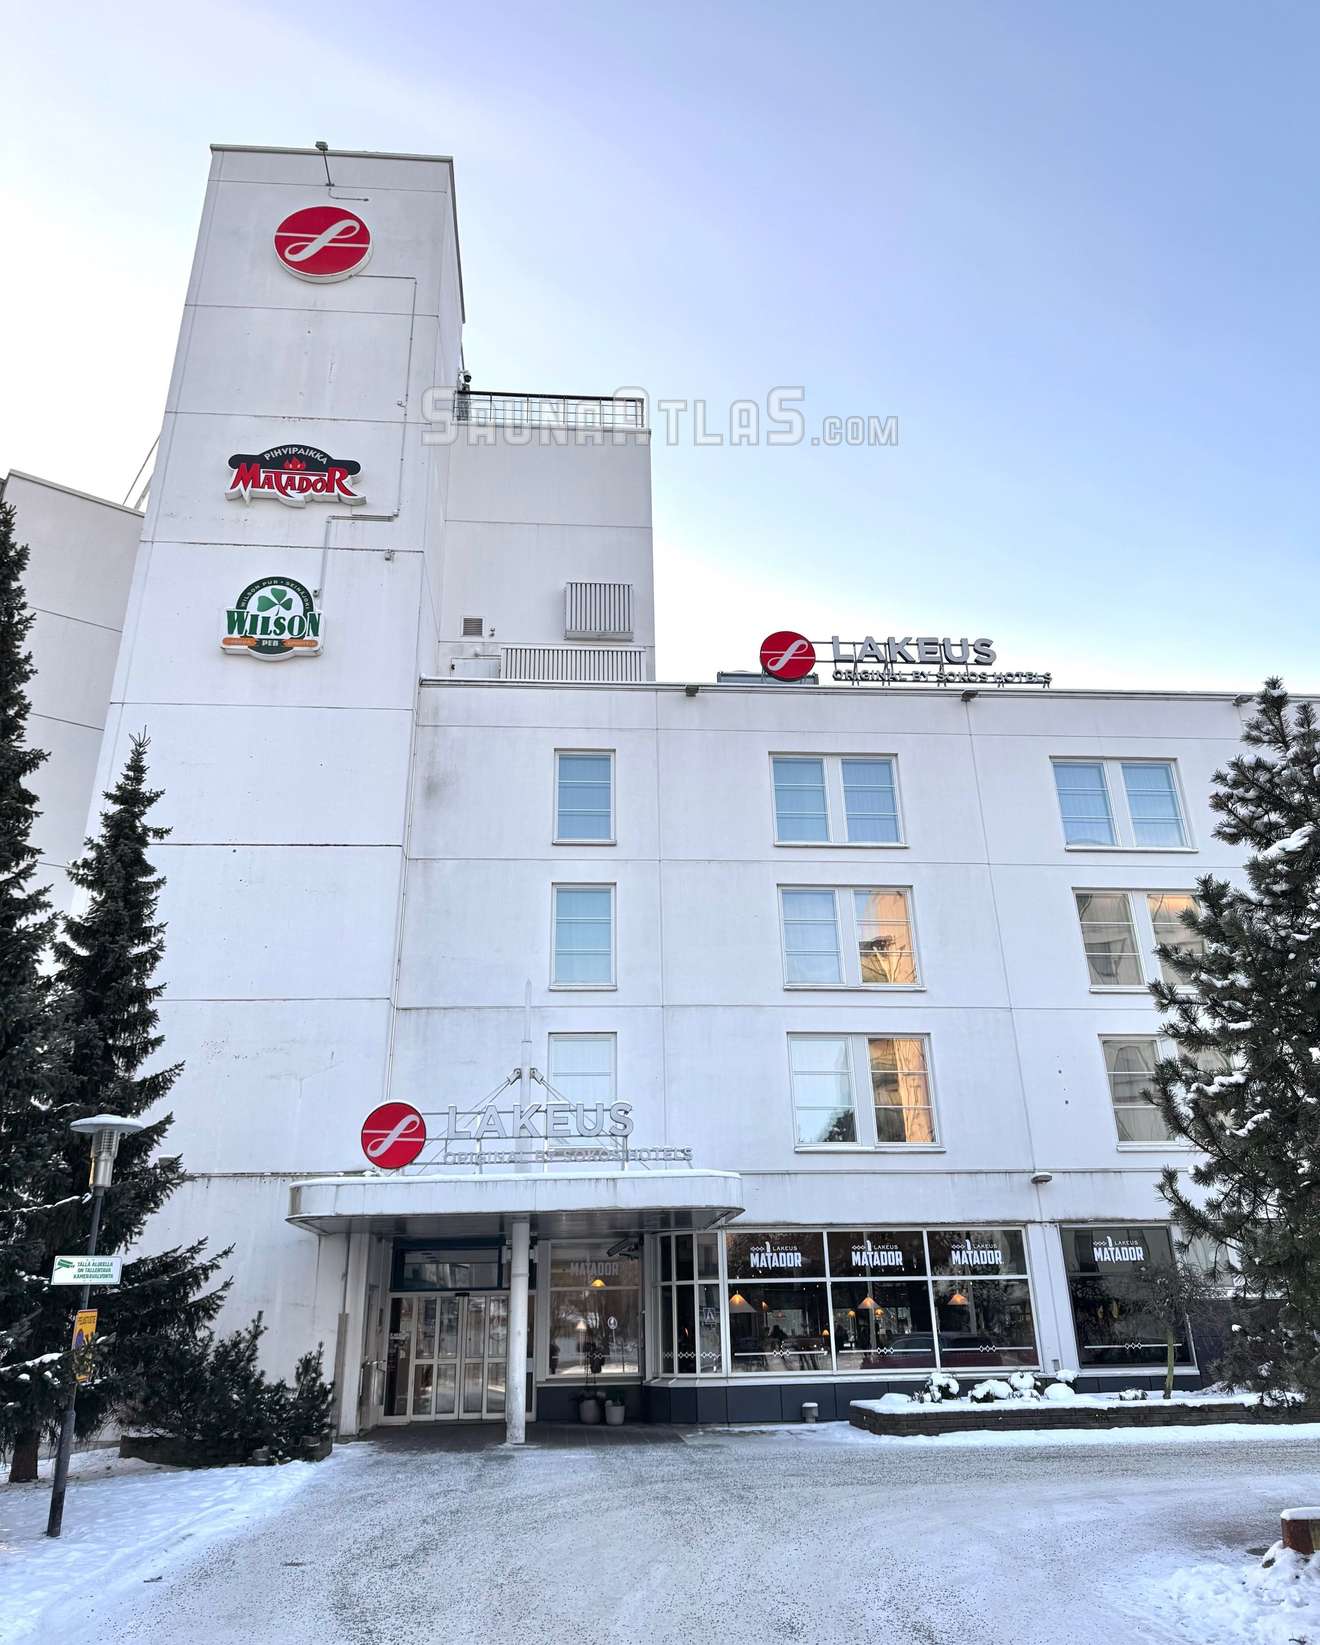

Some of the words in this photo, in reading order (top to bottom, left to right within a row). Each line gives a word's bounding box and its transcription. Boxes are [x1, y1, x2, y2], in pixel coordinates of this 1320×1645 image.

[264, 447, 328, 464] PIHVIPAIKKA
[230, 463, 358, 498] MATADOR
[226, 610, 321, 637] WILSON
[832, 635, 997, 664] LAKEUS
[832, 669, 907, 681] ORIGINAL
[912, 671, 931, 681] BY
[936, 671, 989, 682] SOKOS
[993, 672, 1053, 683] HOTELS
[447, 1101, 634, 1139] LAKEUS
[750, 1252, 802, 1269] MATADOR
[852, 1251, 903, 1268] MATADOR
[951, 1250, 1003, 1267] MATADOR
[1093, 1247, 1145, 1264] MATADOR
[570, 1262, 619, 1277] MATADOR
